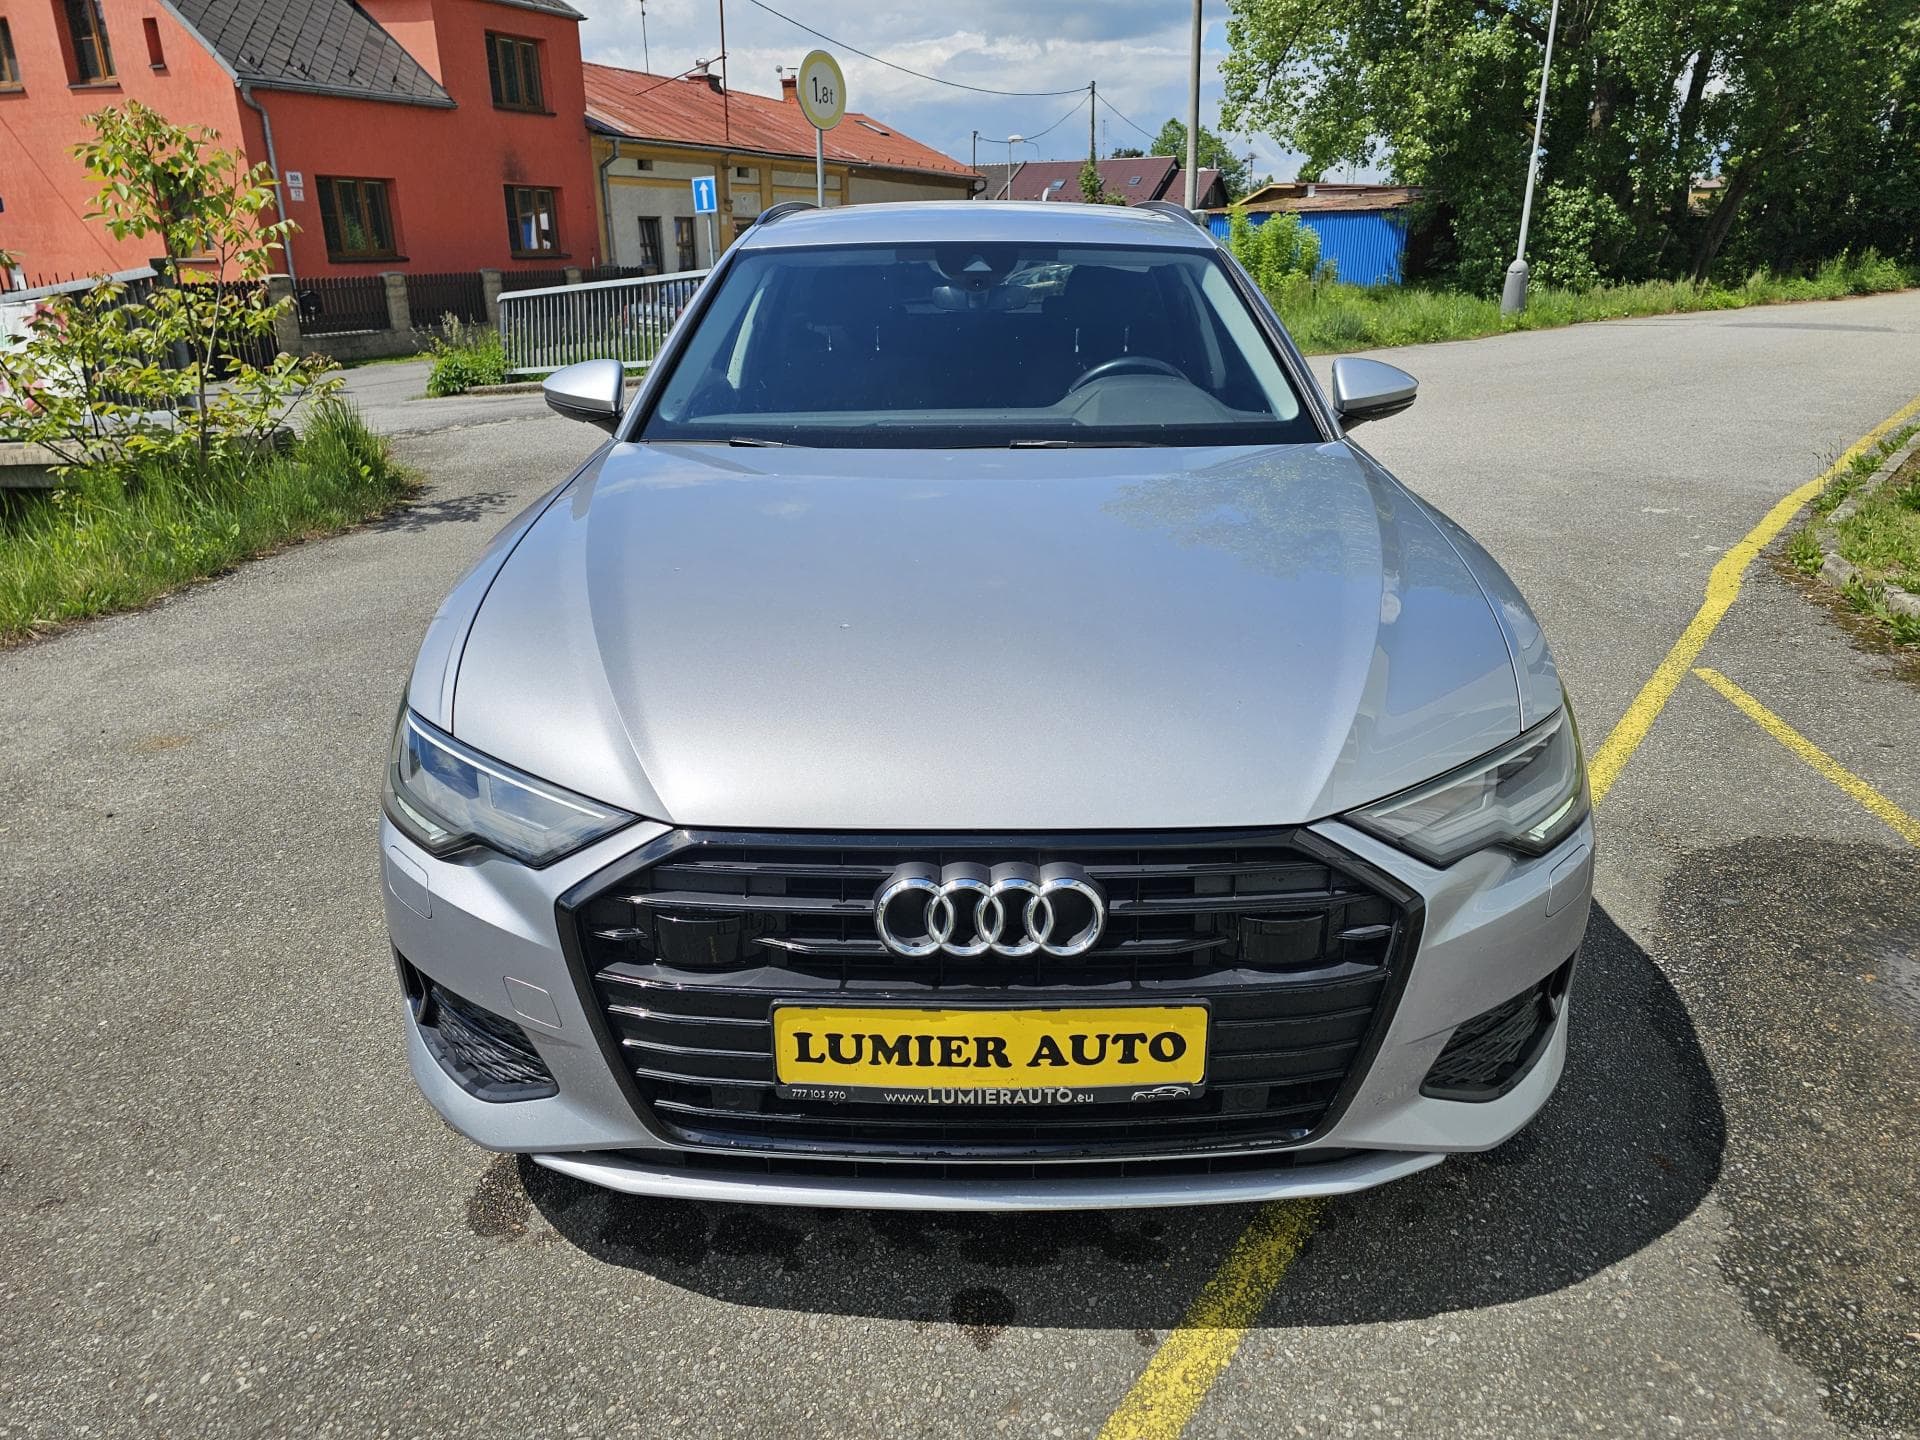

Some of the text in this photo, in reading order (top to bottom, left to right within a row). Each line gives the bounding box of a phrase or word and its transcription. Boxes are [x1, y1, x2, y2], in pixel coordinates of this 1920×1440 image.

[793, 1032, 1187, 1067] LUMIER AUTO
[792, 1089, 847, 1100] 777 103 970
[884, 1087, 1094, 1105] www.LUMIERAUTO.eu
